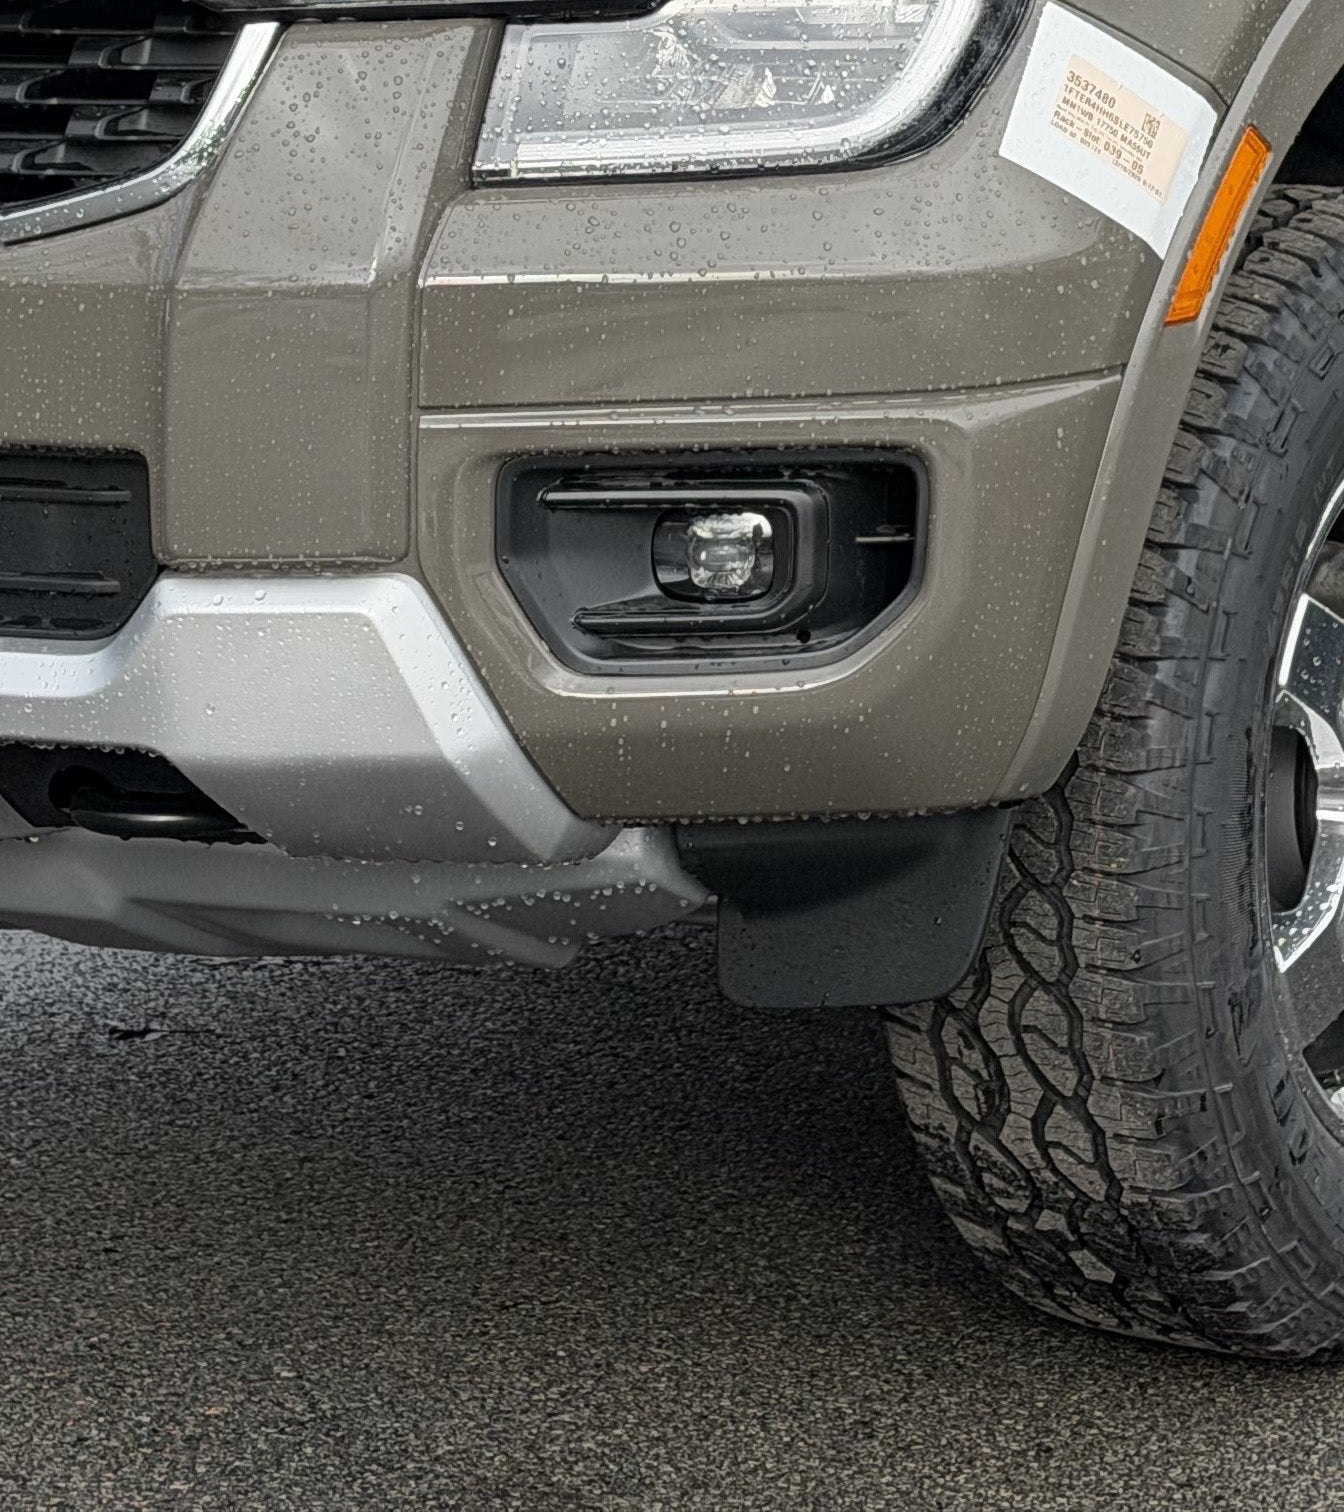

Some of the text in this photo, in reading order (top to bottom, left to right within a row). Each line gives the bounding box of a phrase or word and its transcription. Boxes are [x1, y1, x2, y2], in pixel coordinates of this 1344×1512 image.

[1067, 71, 1116, 108] 3537480
[1054, 110, 1075, 129] Rack
[1103, 141, 1122, 159] 039
[1132, 160, 1144, 175] 05
